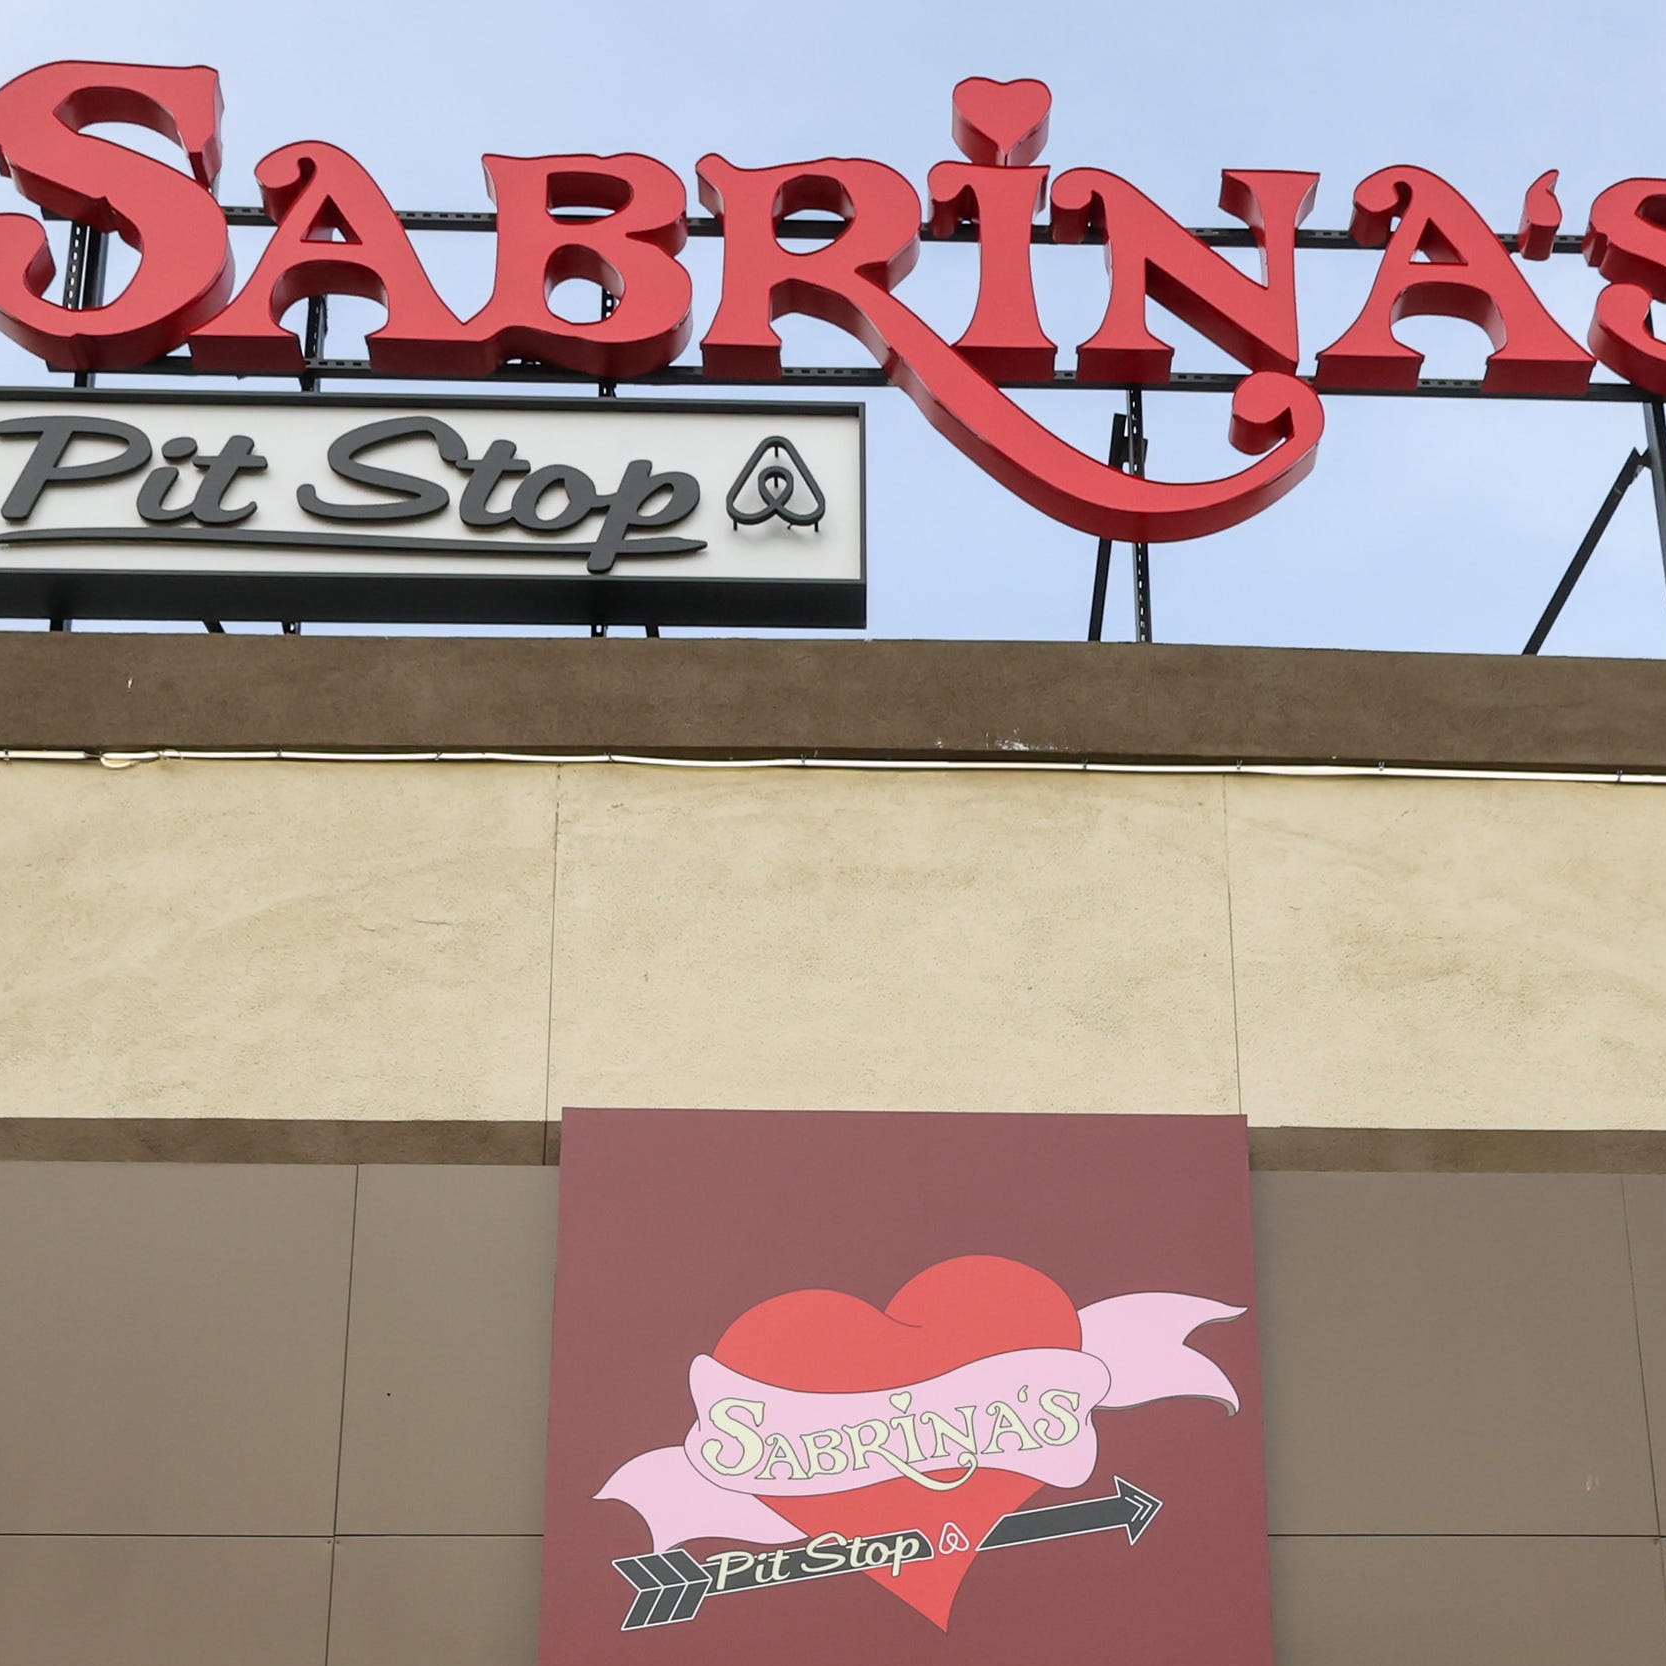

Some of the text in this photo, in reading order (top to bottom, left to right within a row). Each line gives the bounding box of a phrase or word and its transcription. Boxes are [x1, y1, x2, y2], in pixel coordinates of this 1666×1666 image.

[296, 414, 702, 576] Stop
[700, 1383, 1081, 1491] SABRINA'S
[706, 1533, 922, 1592] Pit Stop
